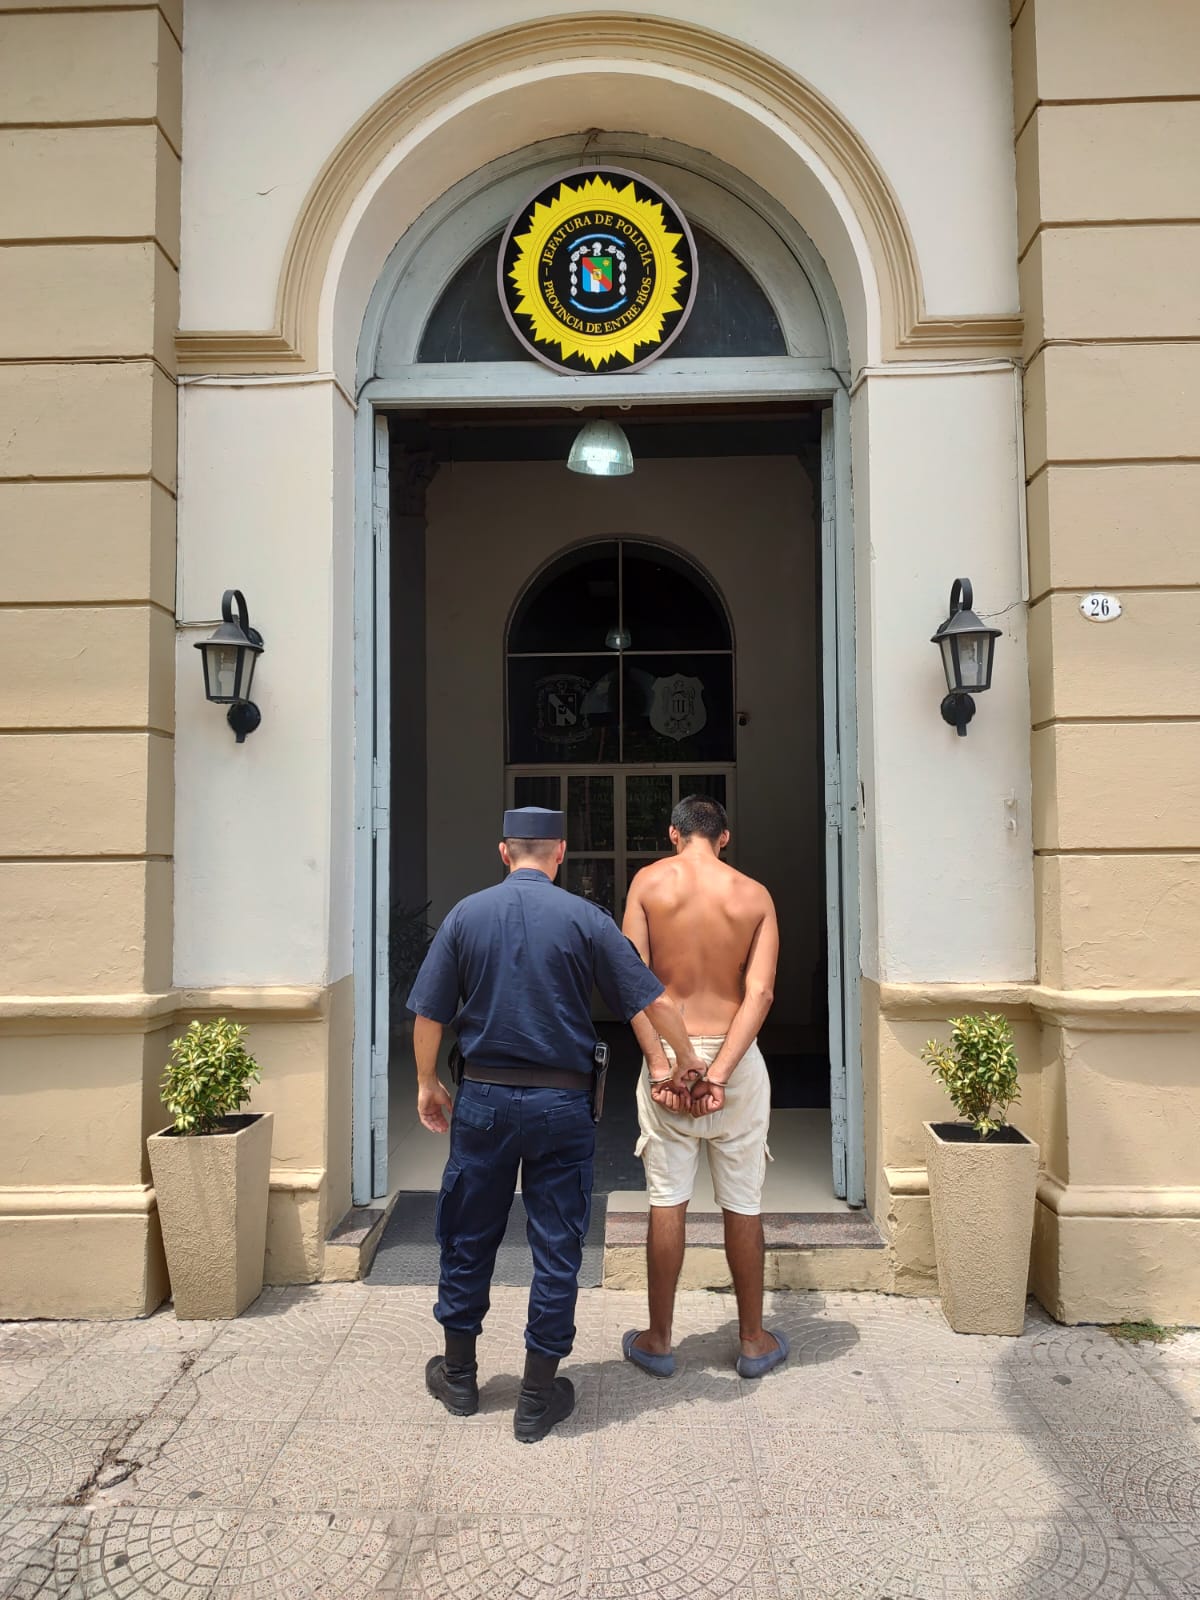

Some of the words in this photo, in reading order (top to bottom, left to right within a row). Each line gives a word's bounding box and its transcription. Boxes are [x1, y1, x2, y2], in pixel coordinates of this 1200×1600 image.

[542, 215, 592, 266] JEFATURA
[595, 213, 614, 226] DE
[615, 218, 652, 266] POLICÍA
[543, 280, 584, 331] PROVINCIA
[586, 323, 602, 334] DE
[604, 304, 641, 332] ENTRE
[636, 277, 652, 306] RÍOS
[1091, 598, 1110, 616] 26
